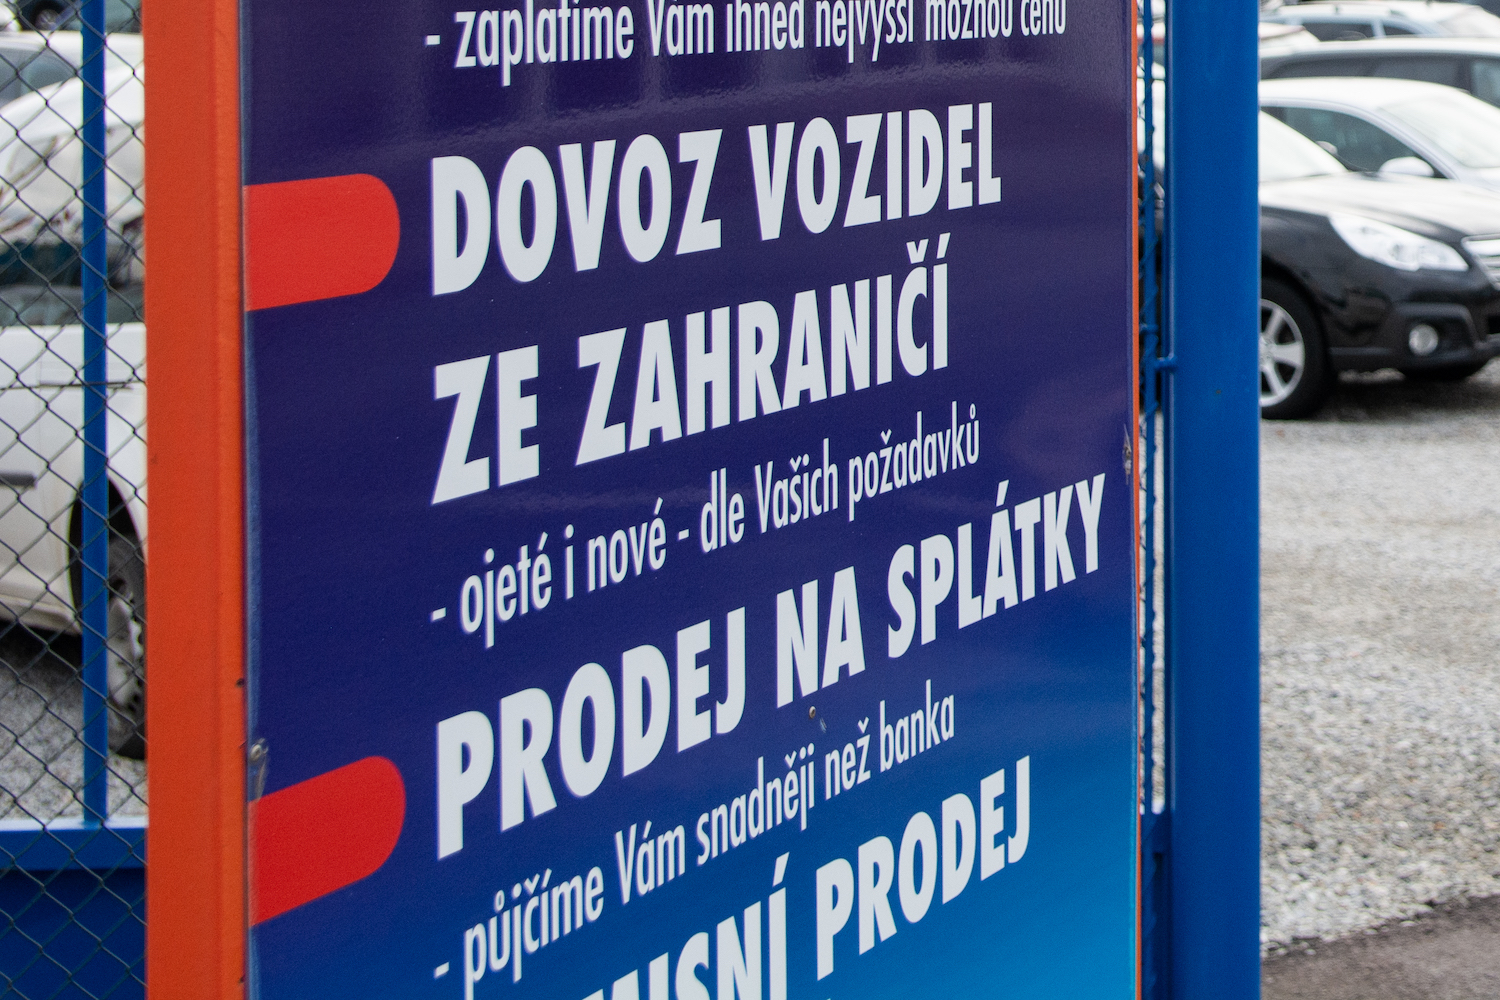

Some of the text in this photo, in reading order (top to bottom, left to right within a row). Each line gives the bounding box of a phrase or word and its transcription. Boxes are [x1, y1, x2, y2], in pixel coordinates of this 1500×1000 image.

[425, 34, 441, 46] -
[431, 102, 1001, 295] DOVOZ VOZIDEL
[432, 233, 951, 504] ZE ZAHRANIČÍ
[431, 401, 981, 648] - ojeté i nové - dle Vašich požadavků
[437, 472, 1106, 859] PRODEJ NA SPLÁTKY
[464, 866, 605, 1000] půjčíme
[615, 820, 685, 904] Vám
[696, 748, 815, 866] snadněji
[825, 716, 871, 800] než
[879, 680, 955, 773] banka
[815, 756, 1030, 981] PRODEJ
